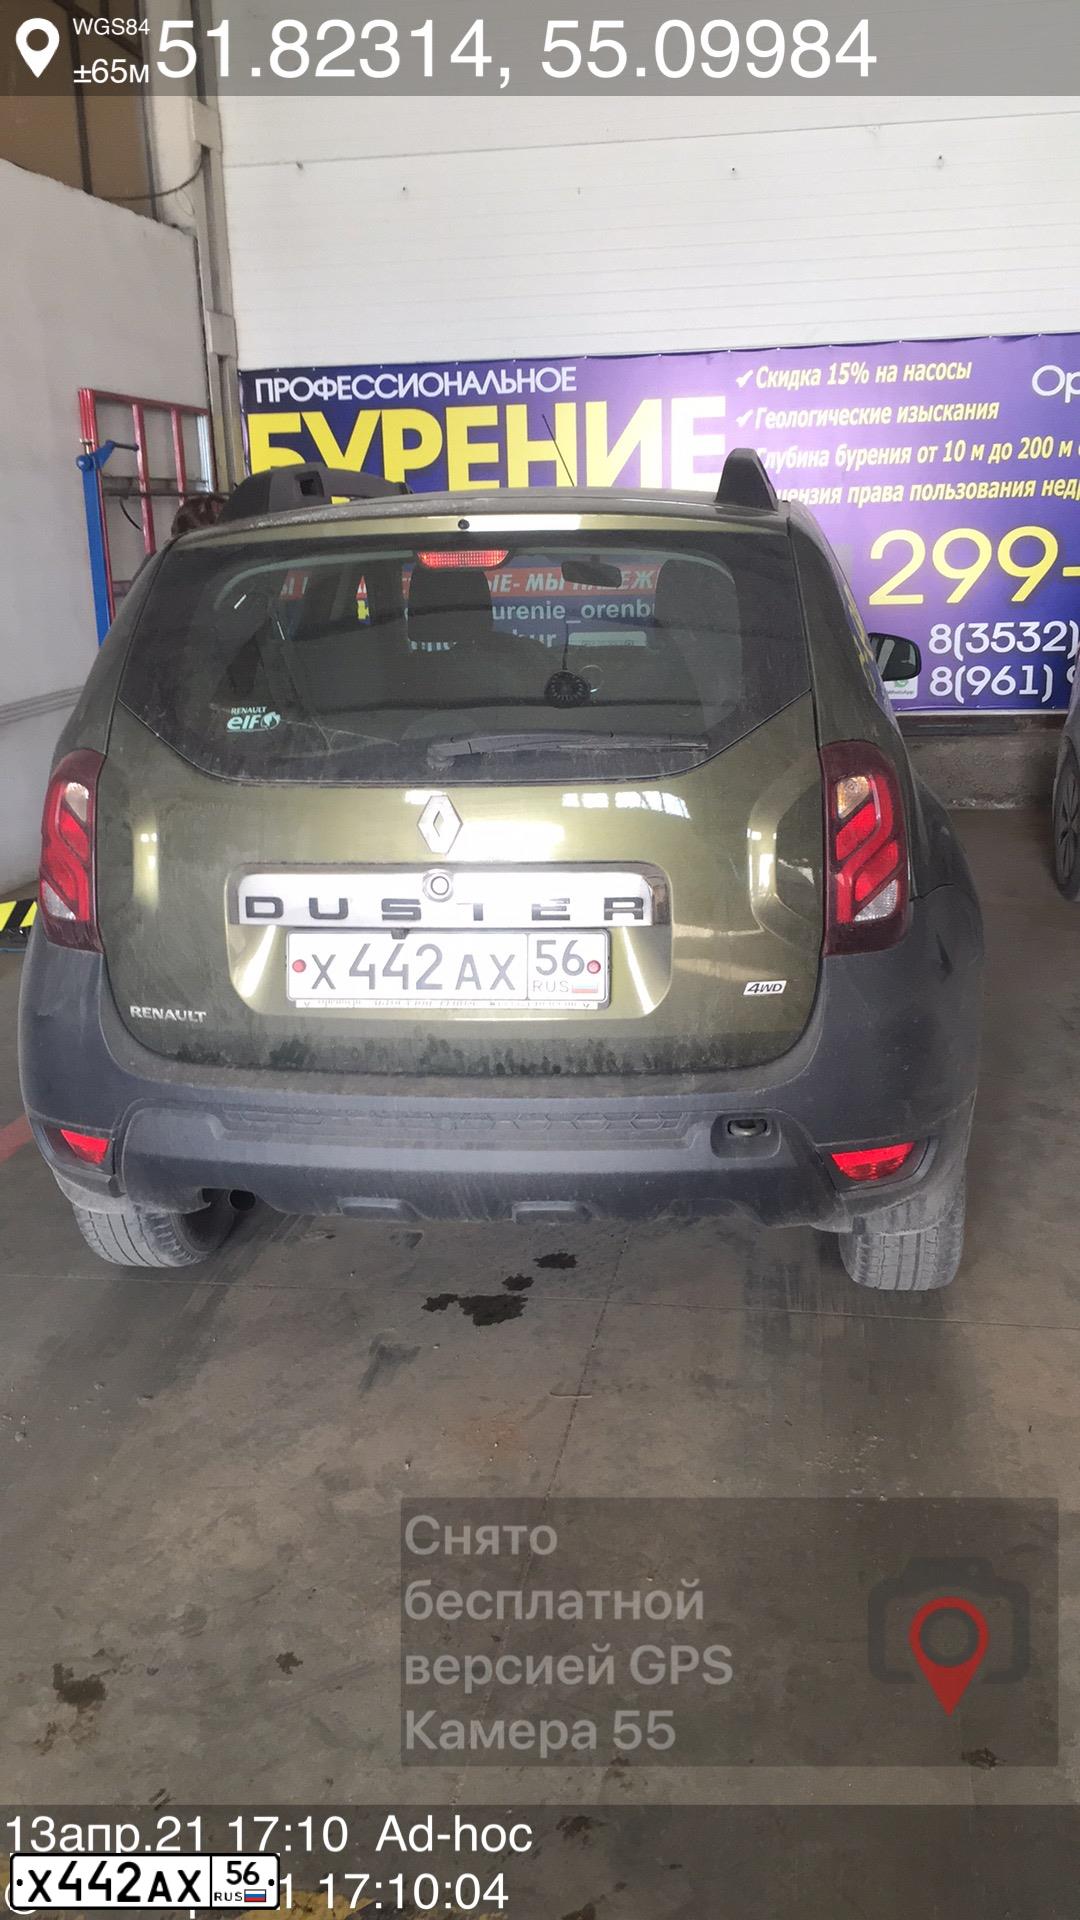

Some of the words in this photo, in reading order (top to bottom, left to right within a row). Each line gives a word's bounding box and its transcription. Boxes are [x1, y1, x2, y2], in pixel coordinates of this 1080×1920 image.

[255, 366, 577, 403] ПРОФЕССИОНАЛЬНОЕ
[755, 366, 821, 390] Скидка
[827, 361, 869, 385] 15%
[875, 364, 896, 383] на
[903, 361, 972, 382] насосы
[755, 406, 892, 430] Геологические
[896, 402, 1000, 424] изыскания
[247, 396, 726, 503] БУРЕНИЕ
[835, 442, 911, 471] бурения
[917, 446, 938, 463] от
[943, 440, 966, 463] 10
[970, 444, 984, 461] м
[987, 443, 1013, 463] до
[1018, 436, 1054, 459] 200
[1059, 440, 1074, 457] м
[848, 485, 904, 508] права
[910, 480, 1036, 502] пользования
[492, 598, 657, 623] urenie_orenb
[928, 620, 1079, 661] 8(3532)
[929, 664, 1053, 703] 8(961)
[227, 715, 261, 729] elf
[231, 706, 267, 715] RENAULT
[245, 896, 645, 921] DUSTER
[535, 939, 585, 976] 56
[532, 979, 569, 993] RUS
[747, 983, 783, 993] 4WD
[130, 1005, 207, 1023] RENAULT
